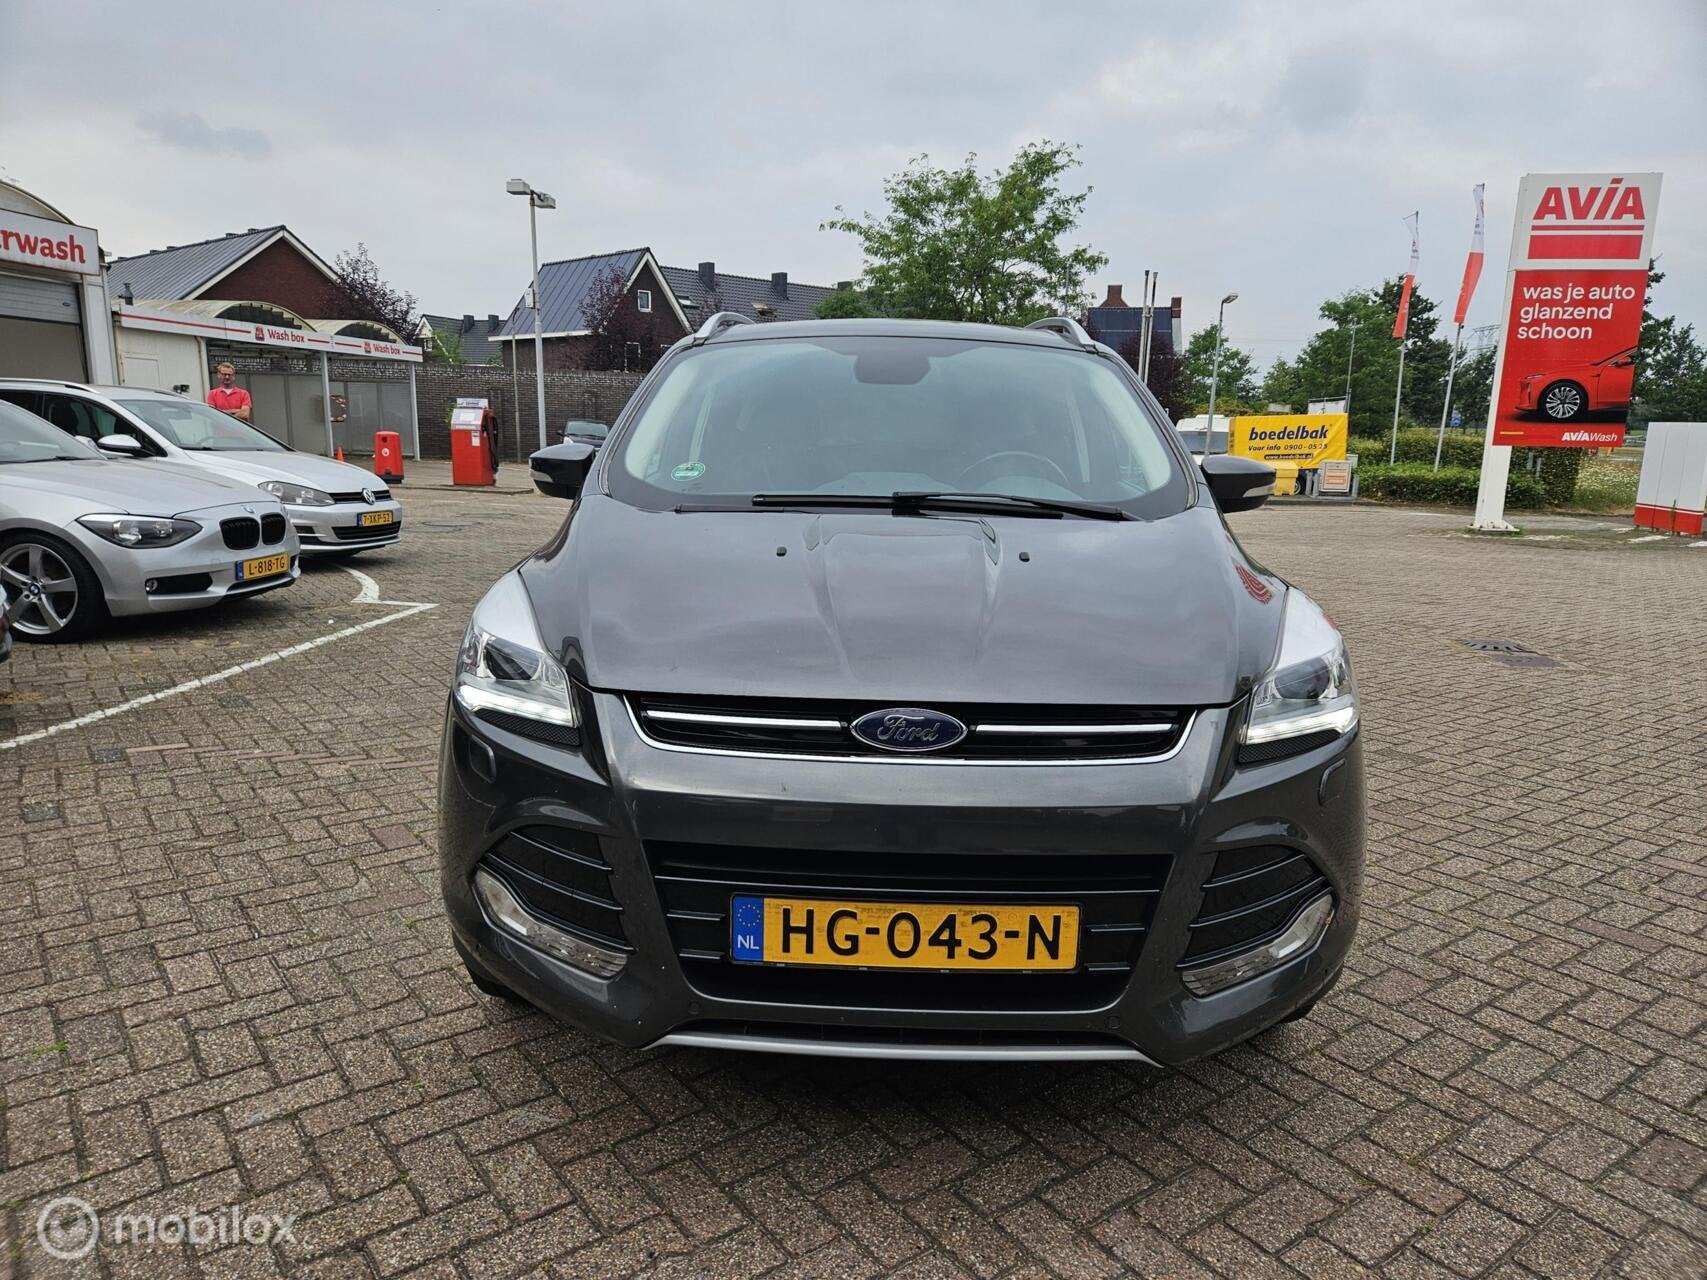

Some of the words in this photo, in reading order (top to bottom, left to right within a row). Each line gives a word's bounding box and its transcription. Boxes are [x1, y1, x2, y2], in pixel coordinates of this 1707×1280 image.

[0, 229, 86, 264] rwash
[1523, 286, 1563, 300] was
[1563, 283, 1585, 303] je
[1589, 284, 1636, 300] auto
[1520, 302, 1614, 323] glanzend
[268, 329, 290, 342] Wash
[291, 332, 305, 343] box
[1517, 322, 1593, 339] schoon
[372, 343, 390, 354] Wash
[390, 346, 401, 355] box
[1249, 425, 1329, 441] boedelbak
[248, 556, 285, 576] L-818-TG
[877, 714, 941, 742] Ford
[737, 934, 760, 950] NL
[781, 907, 1062, 961] HG-043-N
